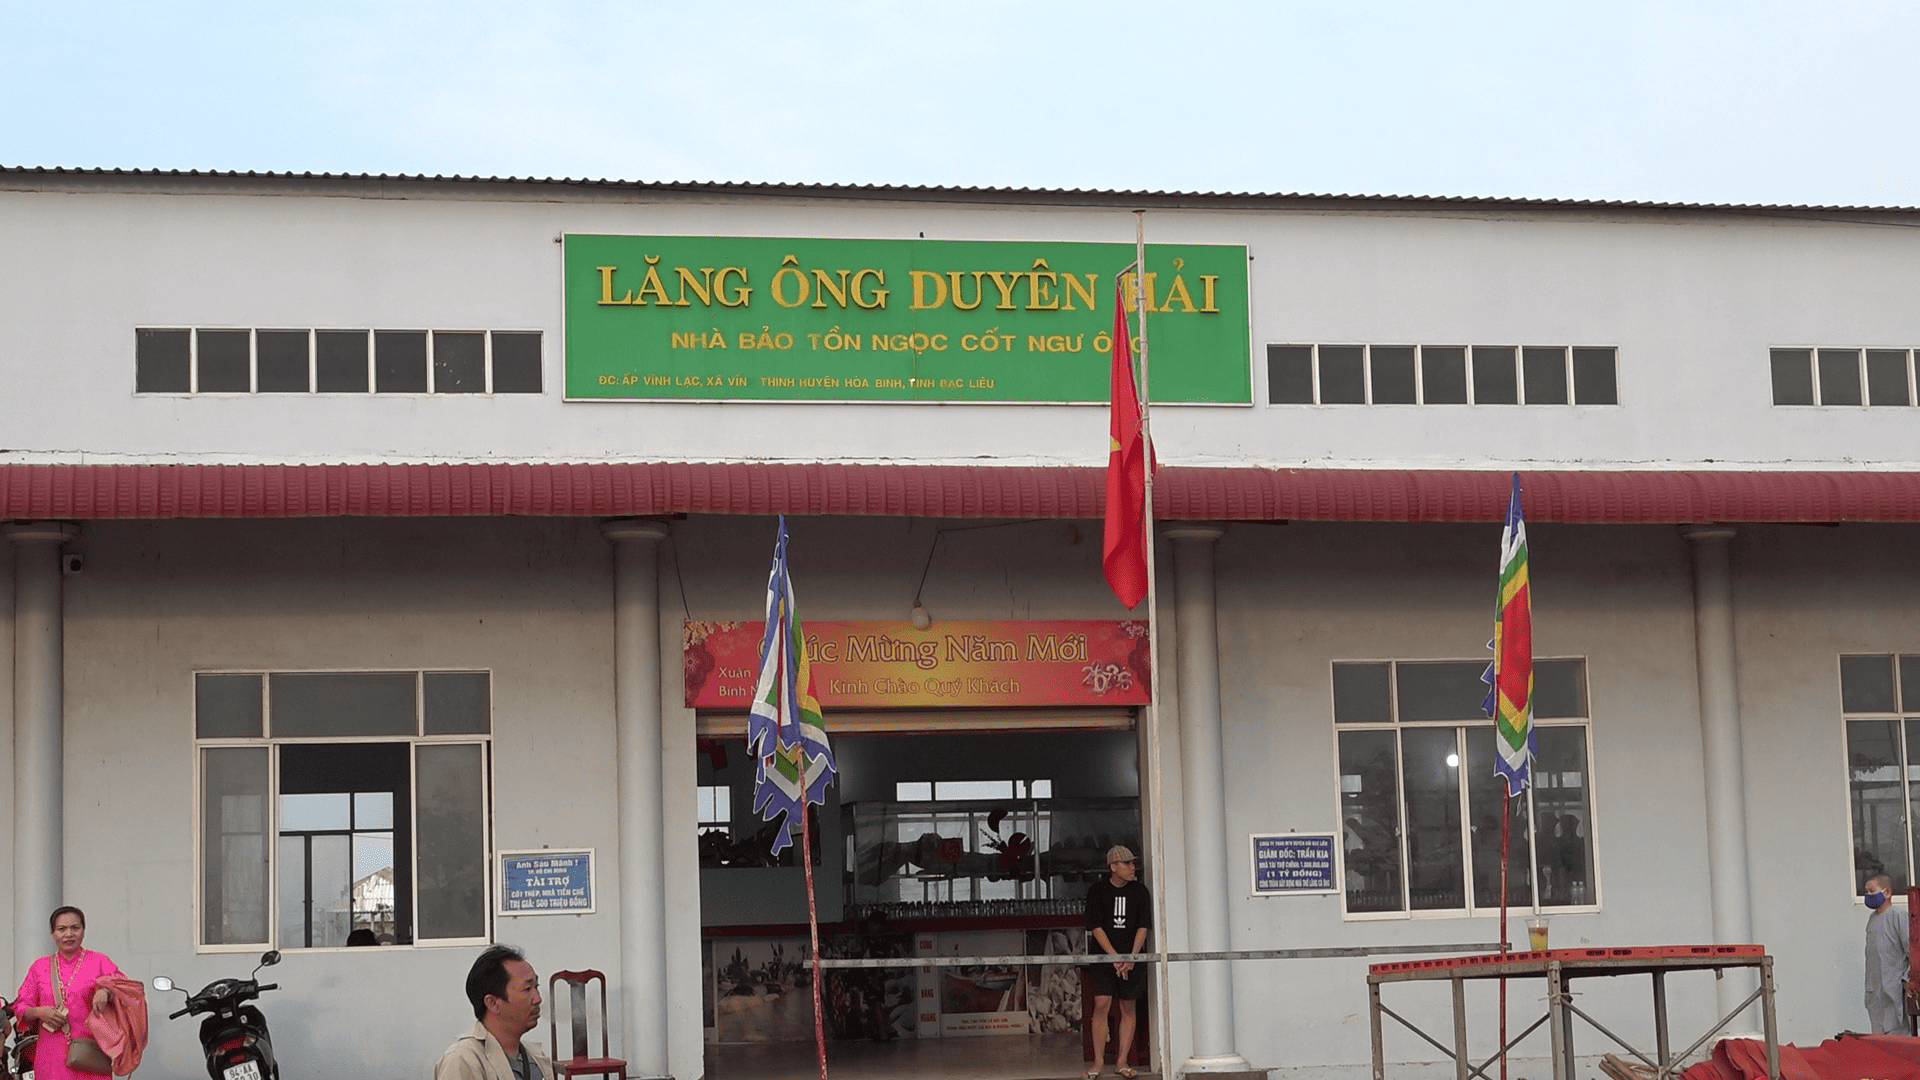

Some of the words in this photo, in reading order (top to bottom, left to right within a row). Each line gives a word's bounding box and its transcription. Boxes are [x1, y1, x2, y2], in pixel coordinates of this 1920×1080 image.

[596, 254, 753, 307] LĂNG
[771, 254, 890, 309] ÔNG
[909, 258, 1099, 311] DUYÊN
[671, 327, 727, 349] NHÀ
[738, 324, 795, 350] BẢO
[806, 325, 862, 351] TỒN
[871, 333, 948, 355] NGỌC
[961, 326, 1017, 352] CỐT
[1028, 333, 1084, 353] NGƯ
[845, 634, 939, 670] Mừng
[945, 634, 1019, 663] Năm
[1026, 633, 1089, 662] Mới
[967, 677, 1020, 694] Khách
[517, 861, 532, 869] Anh
[526, 876, 545, 887] TÀI
